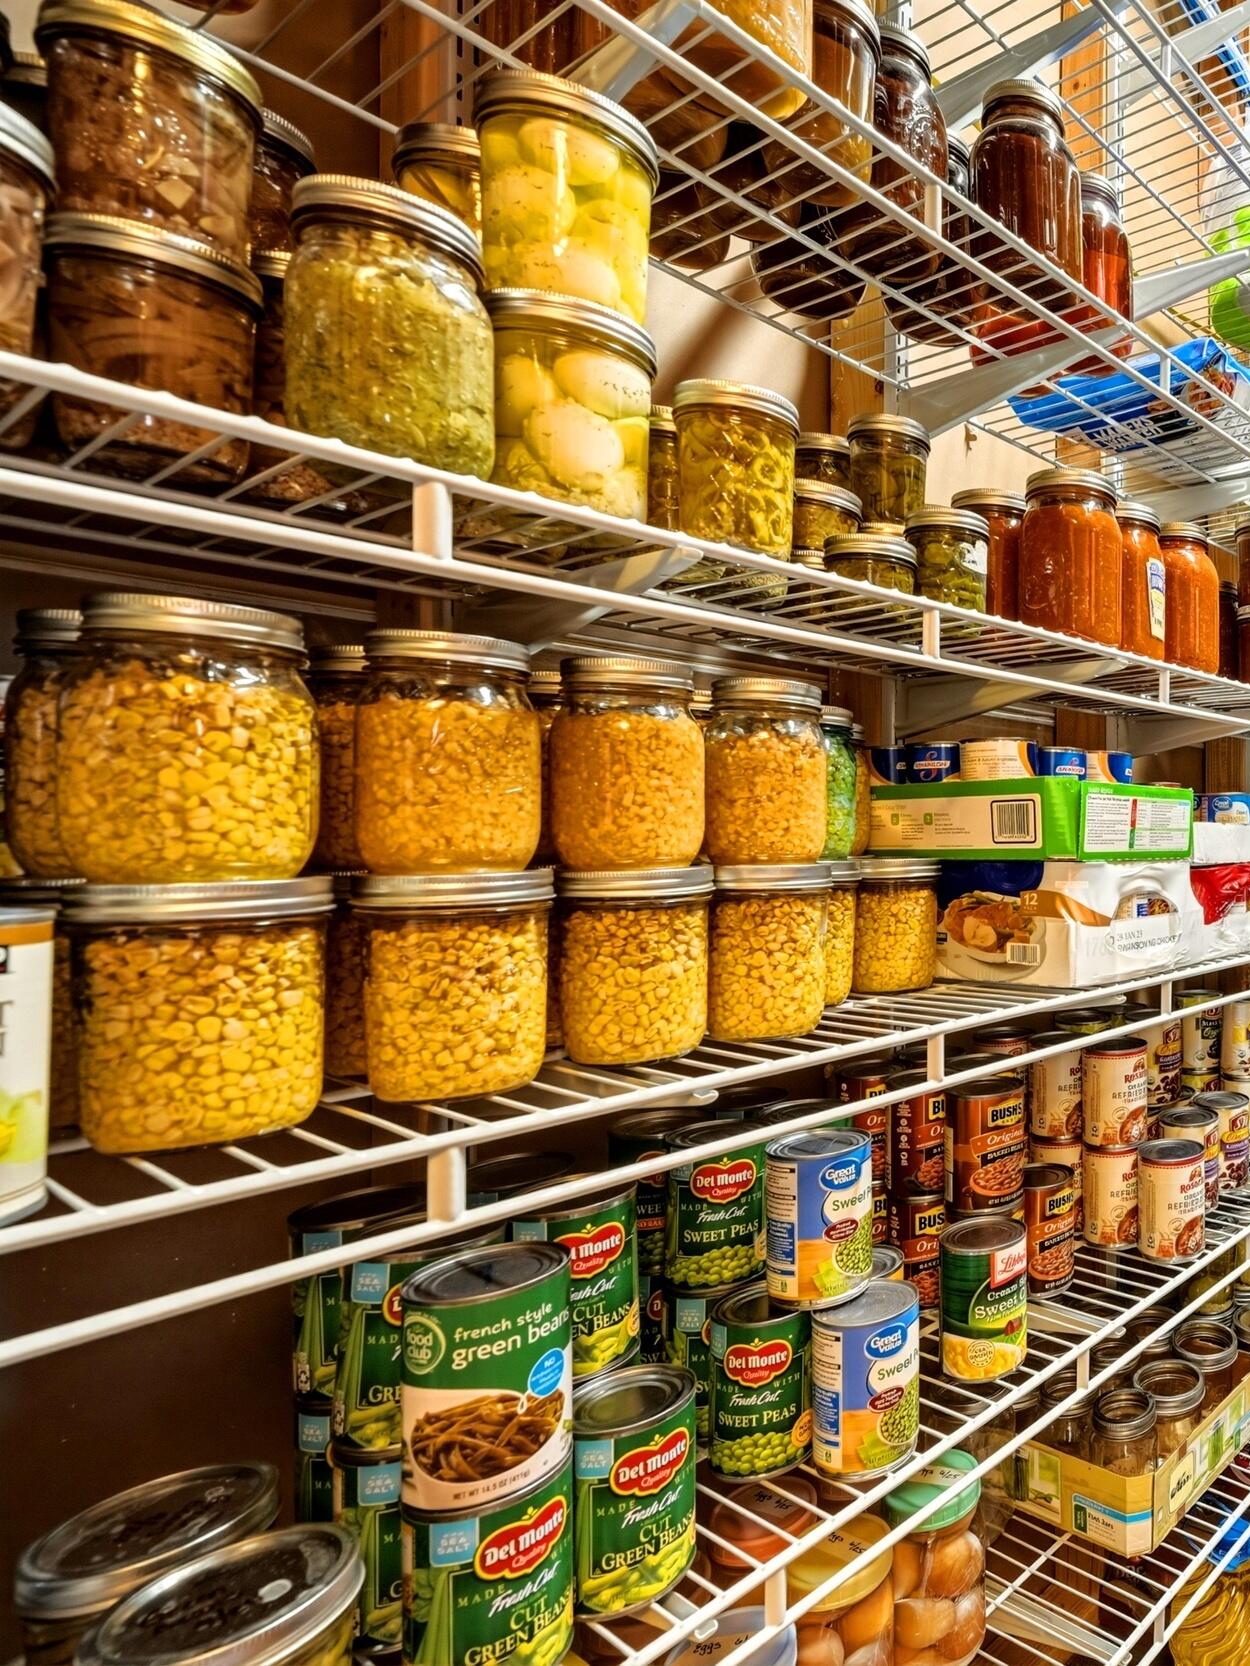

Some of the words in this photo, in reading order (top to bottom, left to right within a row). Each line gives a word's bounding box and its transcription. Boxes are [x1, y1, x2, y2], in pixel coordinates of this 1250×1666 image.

[1023, 893, 1038, 905] 12
[696, 1175, 716, 1188] Del
[717, 1170, 753, 1186] Monte
[826, 1165, 856, 1180] Great
[636, 1204, 662, 1214] WEE
[832, 1191, 866, 1211] Sweet
[683, 1228, 728, 1243] SWEET
[731, 1219, 759, 1239] PEAS
[918, 1213, 945, 1231] BUS
[580, 1233, 621, 1258] Monte
[998, 1250, 1026, 1275] Libby
[987, 1284, 1018, 1302] Cream
[572, 1302, 606, 1322] CUT
[593, 1303, 631, 1332] BEANS
[975, 1294, 1019, 1320] Sweet
[454, 1318, 512, 1343] french
[516, 1303, 553, 1328] style
[367, 1335, 399, 1345] MAD
[406, 1330, 433, 1346] food
[871, 1330, 902, 1349] Great
[406, 1346, 432, 1360] club
[451, 1334, 521, 1371] green
[728, 1356, 746, 1369] Del
[748, 1350, 787, 1368] Monte
[877, 1356, 913, 1381] Sweet
[718, 1411, 759, 1428] SWEET
[762, 1403, 797, 1425] PEAS
[618, 1465, 644, 1483] Del
[646, 1438, 687, 1474] Monte
[453, 1491, 466, 1500] NET
[482, 1483, 497, 1494] 14.5
[499, 1480, 508, 1488] OZ
[596, 1498, 636, 1517] MADE
[621, 1501, 658, 1529] Fresh
[484, 1544, 517, 1567] Del
[519, 1508, 564, 1551] Monte
[639, 1514, 672, 1542] CUT
[601, 1540, 656, 1571] GREEN
[659, 1510, 694, 1549] BEANS
[457, 1584, 507, 1608] MADE
[488, 1581, 533, 1618] Fresh
[510, 1595, 548, 1630] CUT
[464, 1626, 530, 1666] GREEN
[533, 1586, 572, 1635] BEANS
[693, 1642, 722, 1656] Eggs
